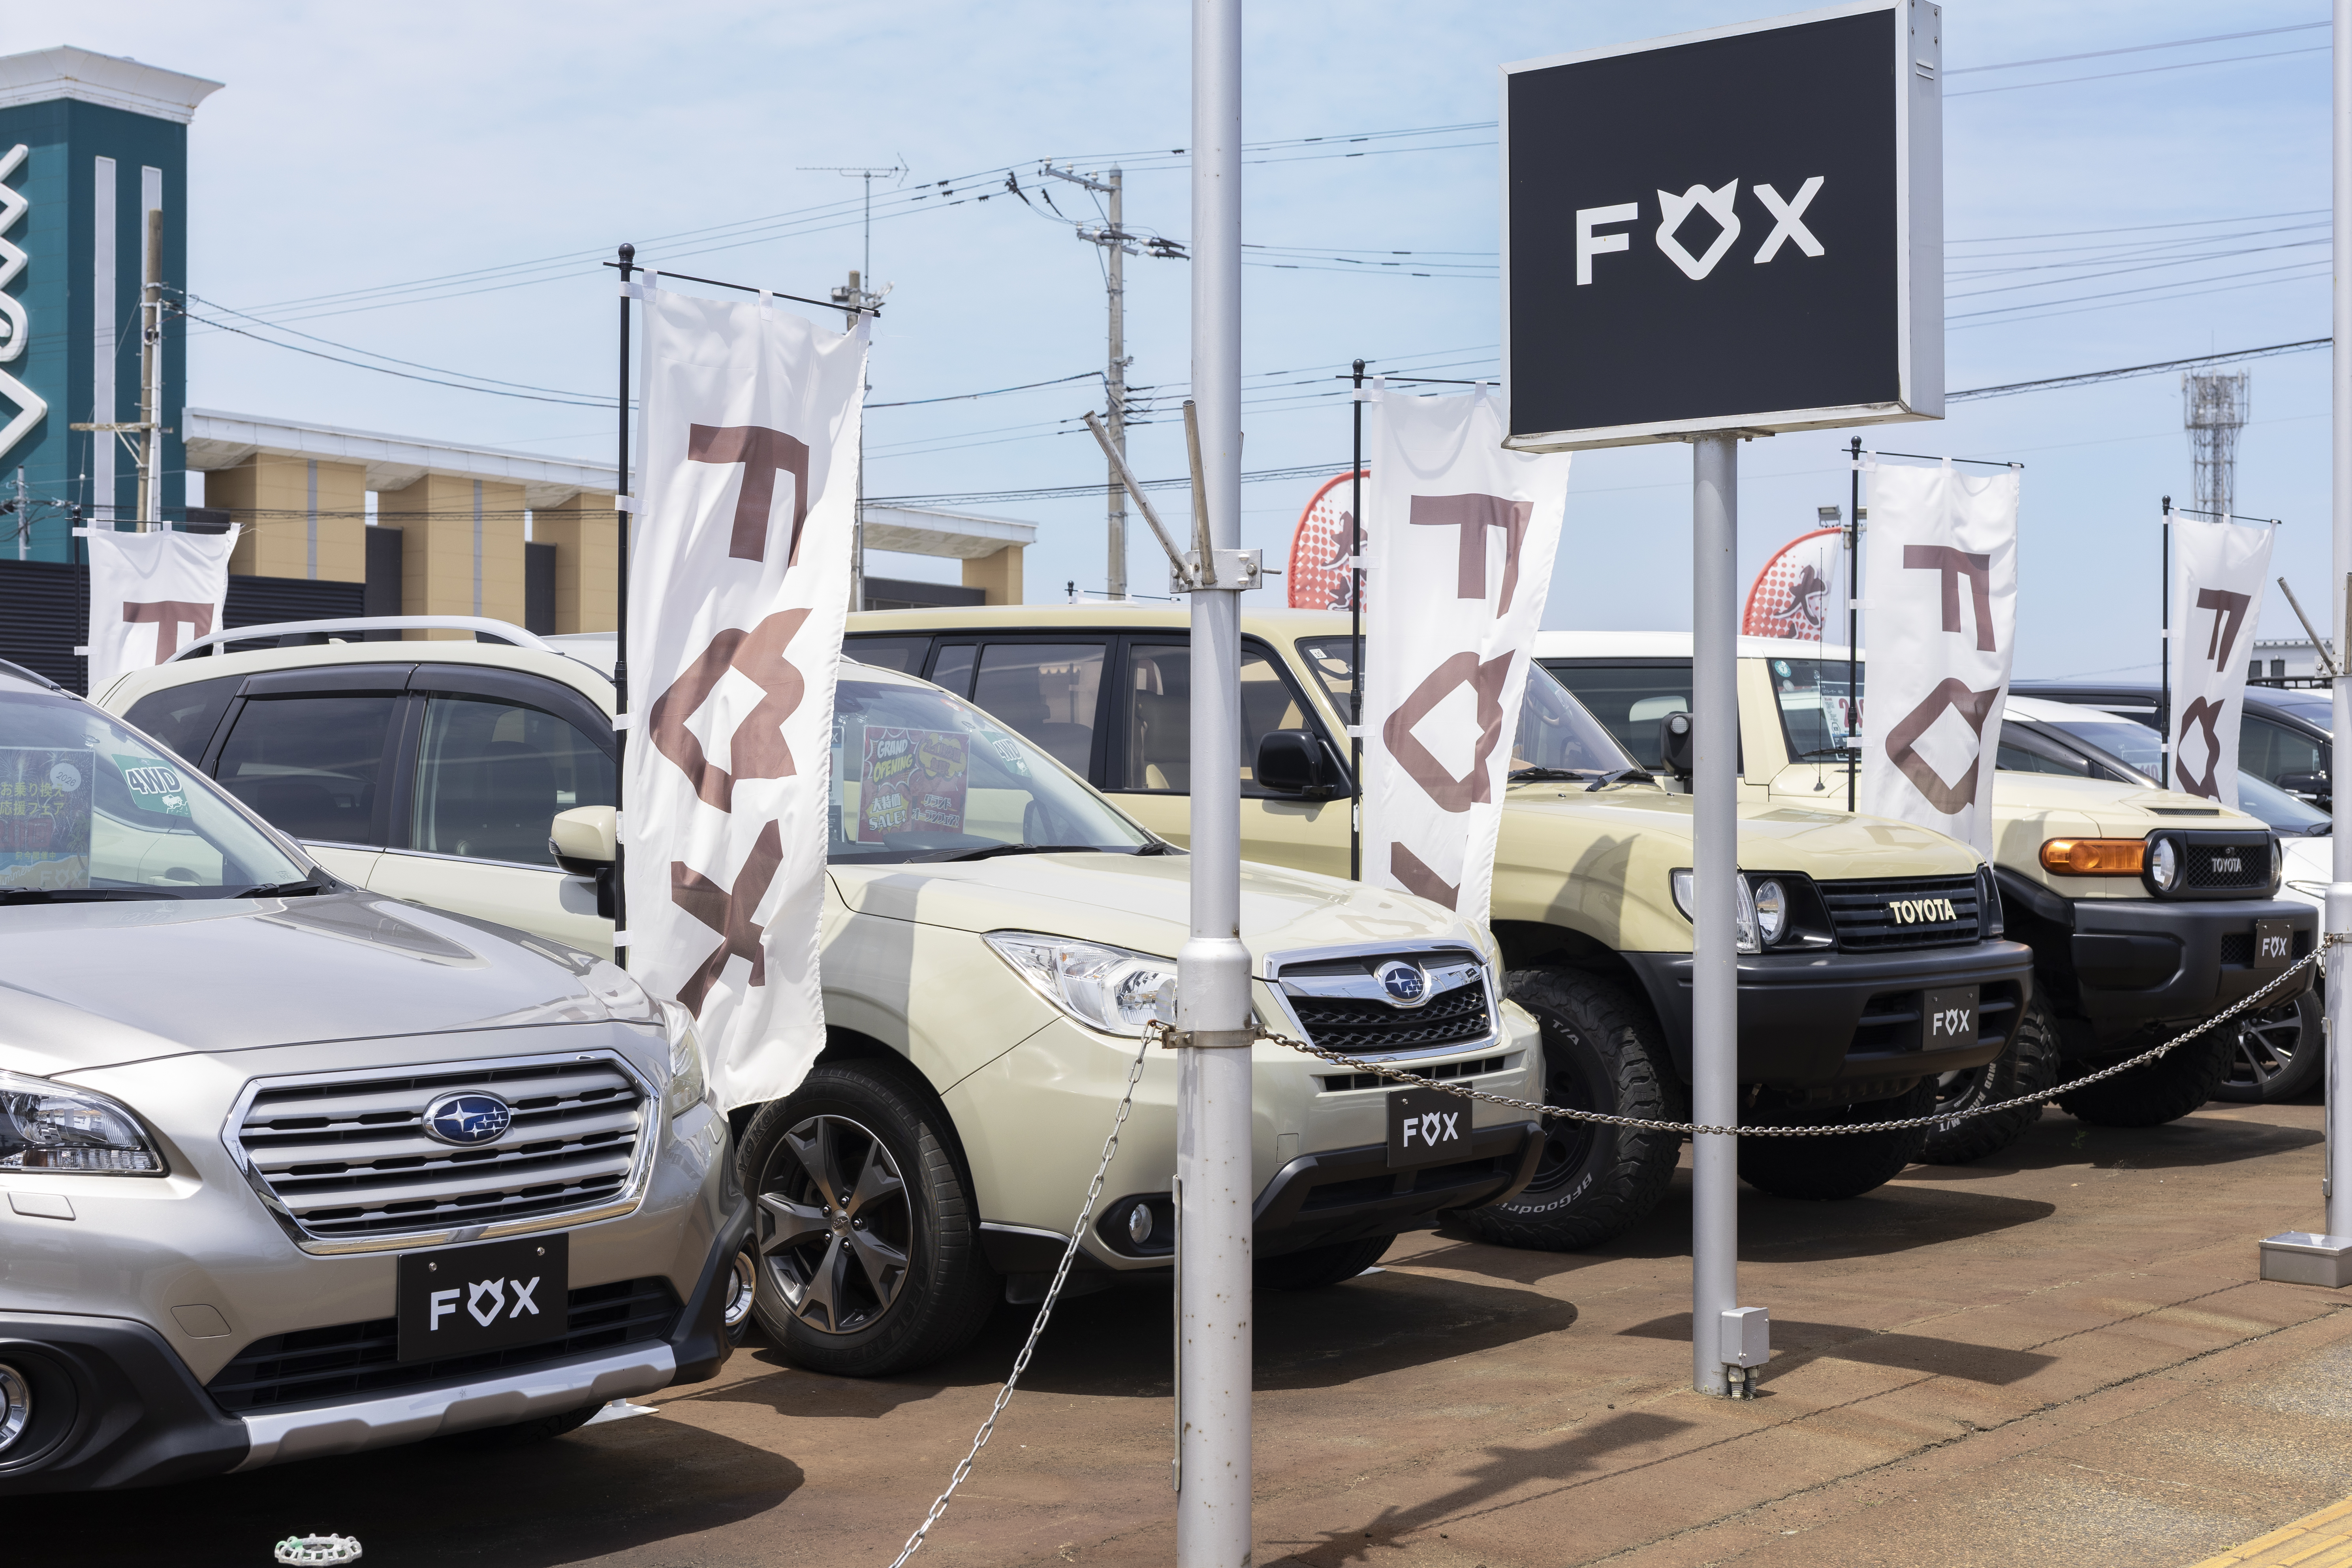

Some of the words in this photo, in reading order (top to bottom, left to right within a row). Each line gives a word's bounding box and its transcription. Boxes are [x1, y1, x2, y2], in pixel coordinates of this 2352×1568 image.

[1576, 176, 1825, 286] FOX
[1885, 544, 2000, 814] FO
[2175, 587, 2252, 803] FO
[877, 739, 908, 759] GRAND
[56, 771, 76, 787] 2026
[125, 767, 182, 794] 4WD
[873, 754, 913, 783] OPENING
[0, 782, 65, 798] お乗り換え
[923, 794, 952, 810] グランド
[0, 800, 65, 816] 応援フェア
[871, 793, 902, 813] 大特価
[869, 809, 906, 831] SALE!
[2211, 857, 2242, 872] TOYOTA
[40, 869, 85, 887] FOX
[1889, 899, 1957, 924] TOYOTA
[2262, 936, 2286, 958] FOX
[1552, 1019, 1580, 1046] T/A
[1933, 1008, 1970, 1036] FOX
[1403, 1111, 1458, 1147] FOX
[1495, 1172, 1593, 1215] BFGoodri
[430, 1276, 540, 1331] FOX
